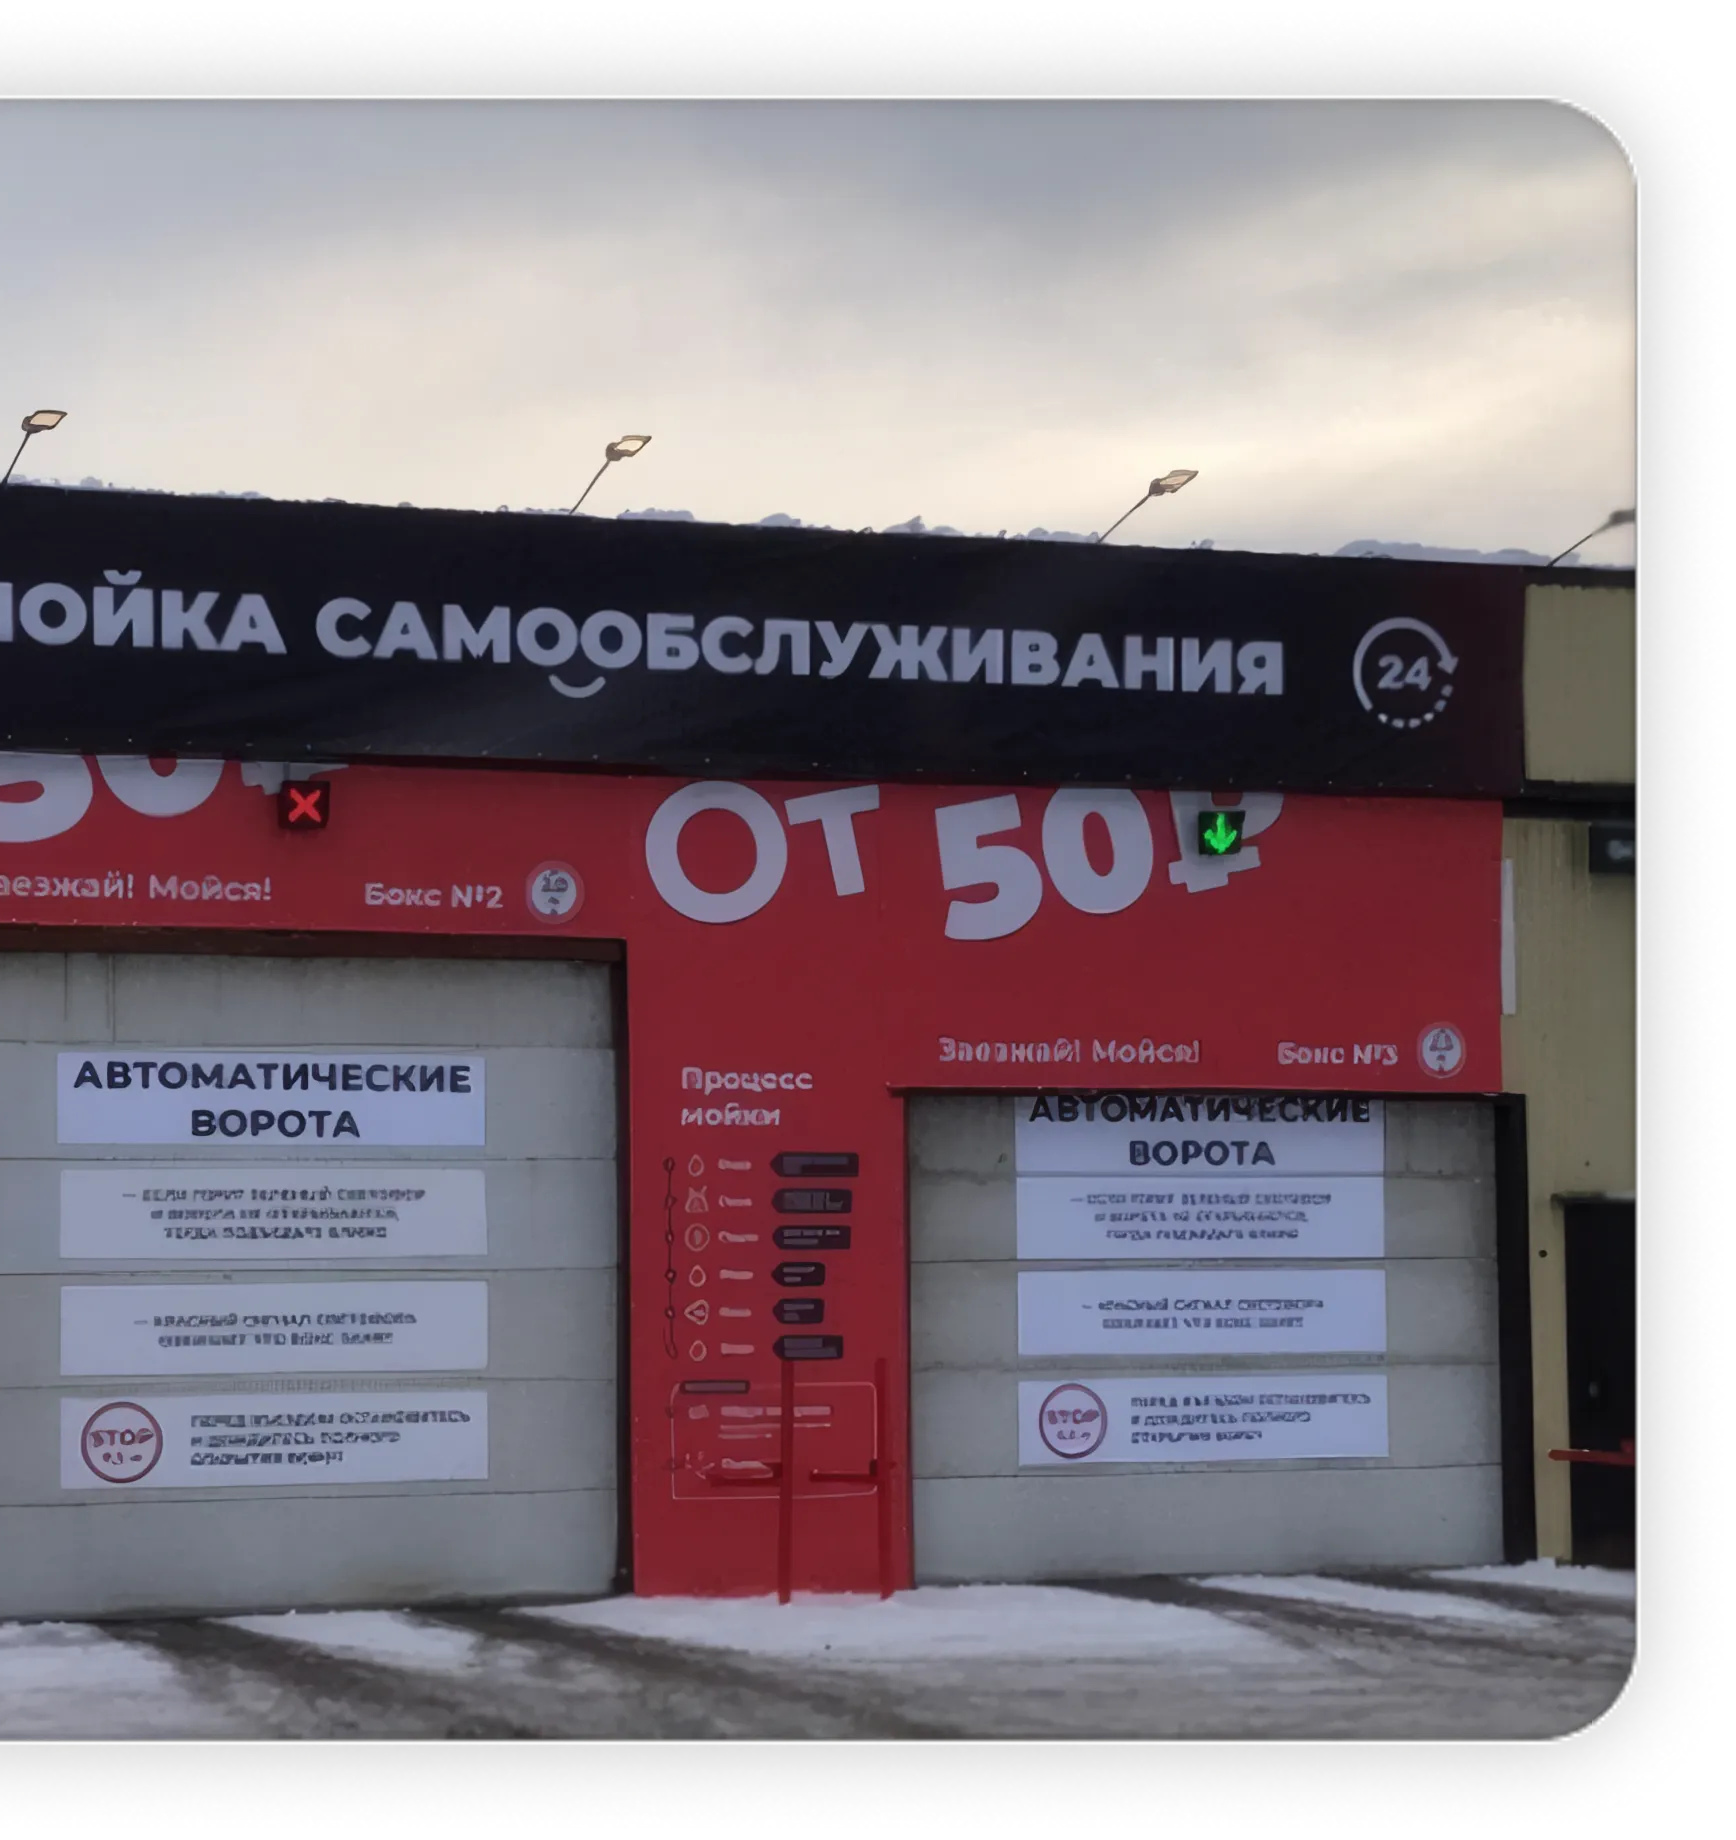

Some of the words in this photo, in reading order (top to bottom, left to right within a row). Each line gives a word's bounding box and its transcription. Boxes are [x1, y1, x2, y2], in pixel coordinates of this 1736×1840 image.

[315, 597, 1284, 696] САМООБСЛУЖИВАНИЯ
[1378, 655, 1432, 690] 24
[644, 780, 880, 924] ОТ
[149, 874, 272, 901] Мойся!
[364, 882, 442, 907] Бокс
[73, 1060, 472, 1094] АВТОМАТИЧЕСКИЕ
[681, 1066, 813, 1096] Процесс
[191, 1109, 361, 1139] ВОРОТА
[680, 1102, 781, 1126] мойки
[1129, 1139, 1276, 1167] ВОРОТА
